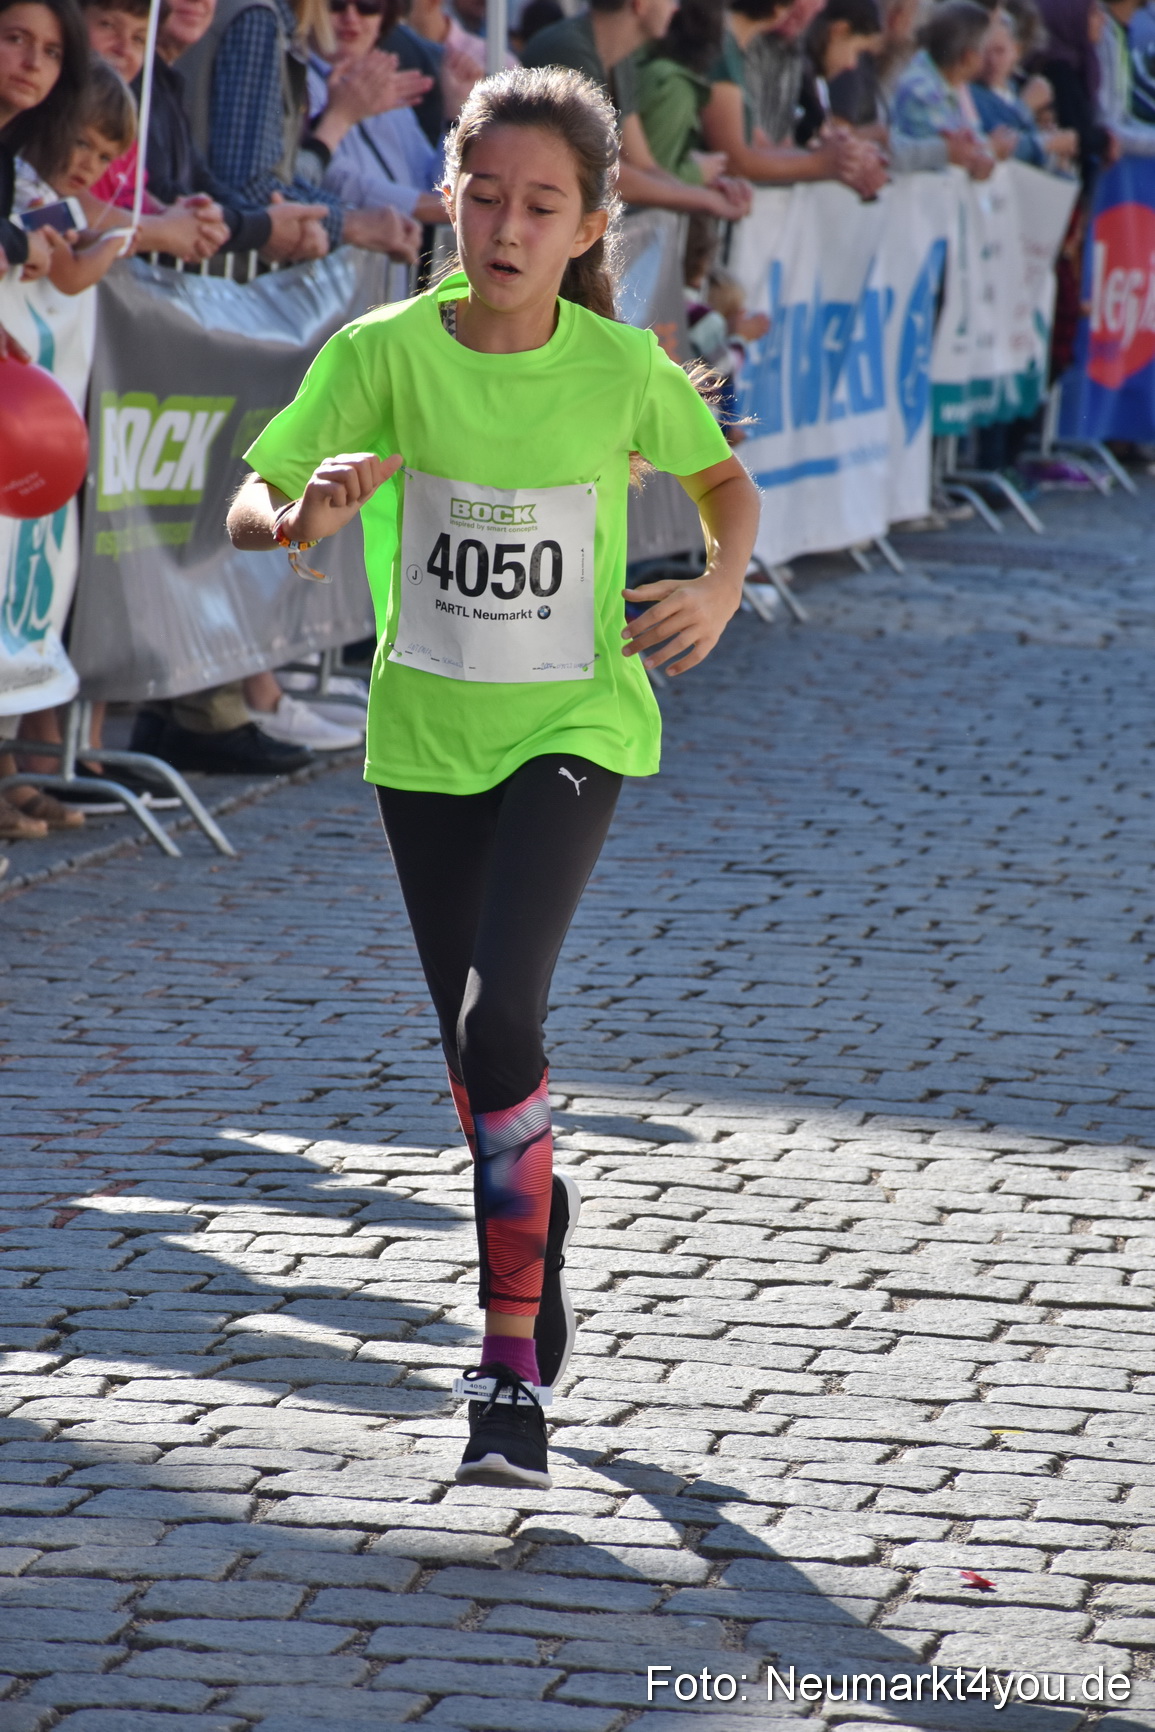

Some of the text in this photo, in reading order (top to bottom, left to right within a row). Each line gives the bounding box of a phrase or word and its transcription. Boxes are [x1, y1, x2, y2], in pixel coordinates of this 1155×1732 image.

[100, 402, 229, 500] BOCK
[450, 497, 537, 525] BOCK
[450, 518, 538, 533] inspired by smart concepts
[426, 532, 563, 600] 4050
[435, 599, 532, 621] PARTL Neumarkt
